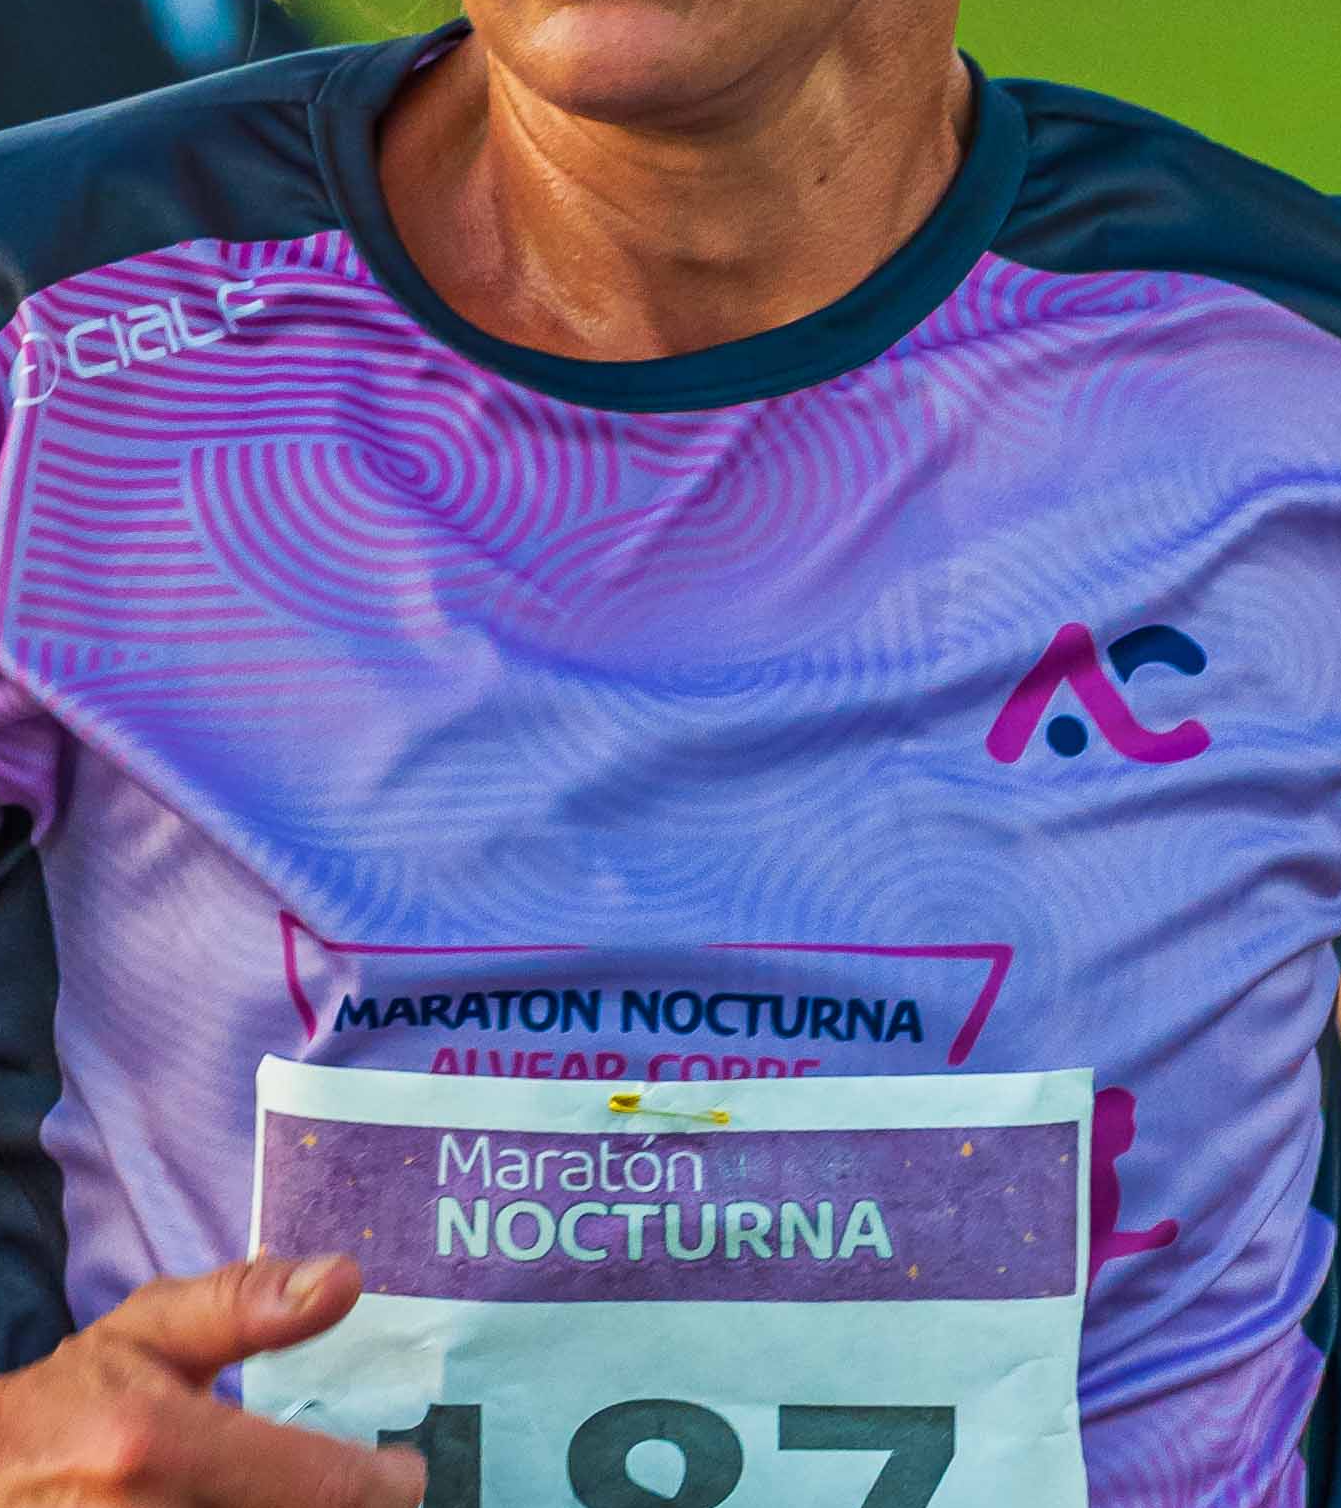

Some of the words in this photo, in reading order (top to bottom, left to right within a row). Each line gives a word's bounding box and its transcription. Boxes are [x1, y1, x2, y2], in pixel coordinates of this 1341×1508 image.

[984, 621, 1213, 766] AC
[333, 988, 602, 1033] MARATON
[620, 989, 924, 1045] NOCTURNA
[436, 1132, 704, 1196] Maratón
[435, 1197, 894, 1263] NOCTURNA
